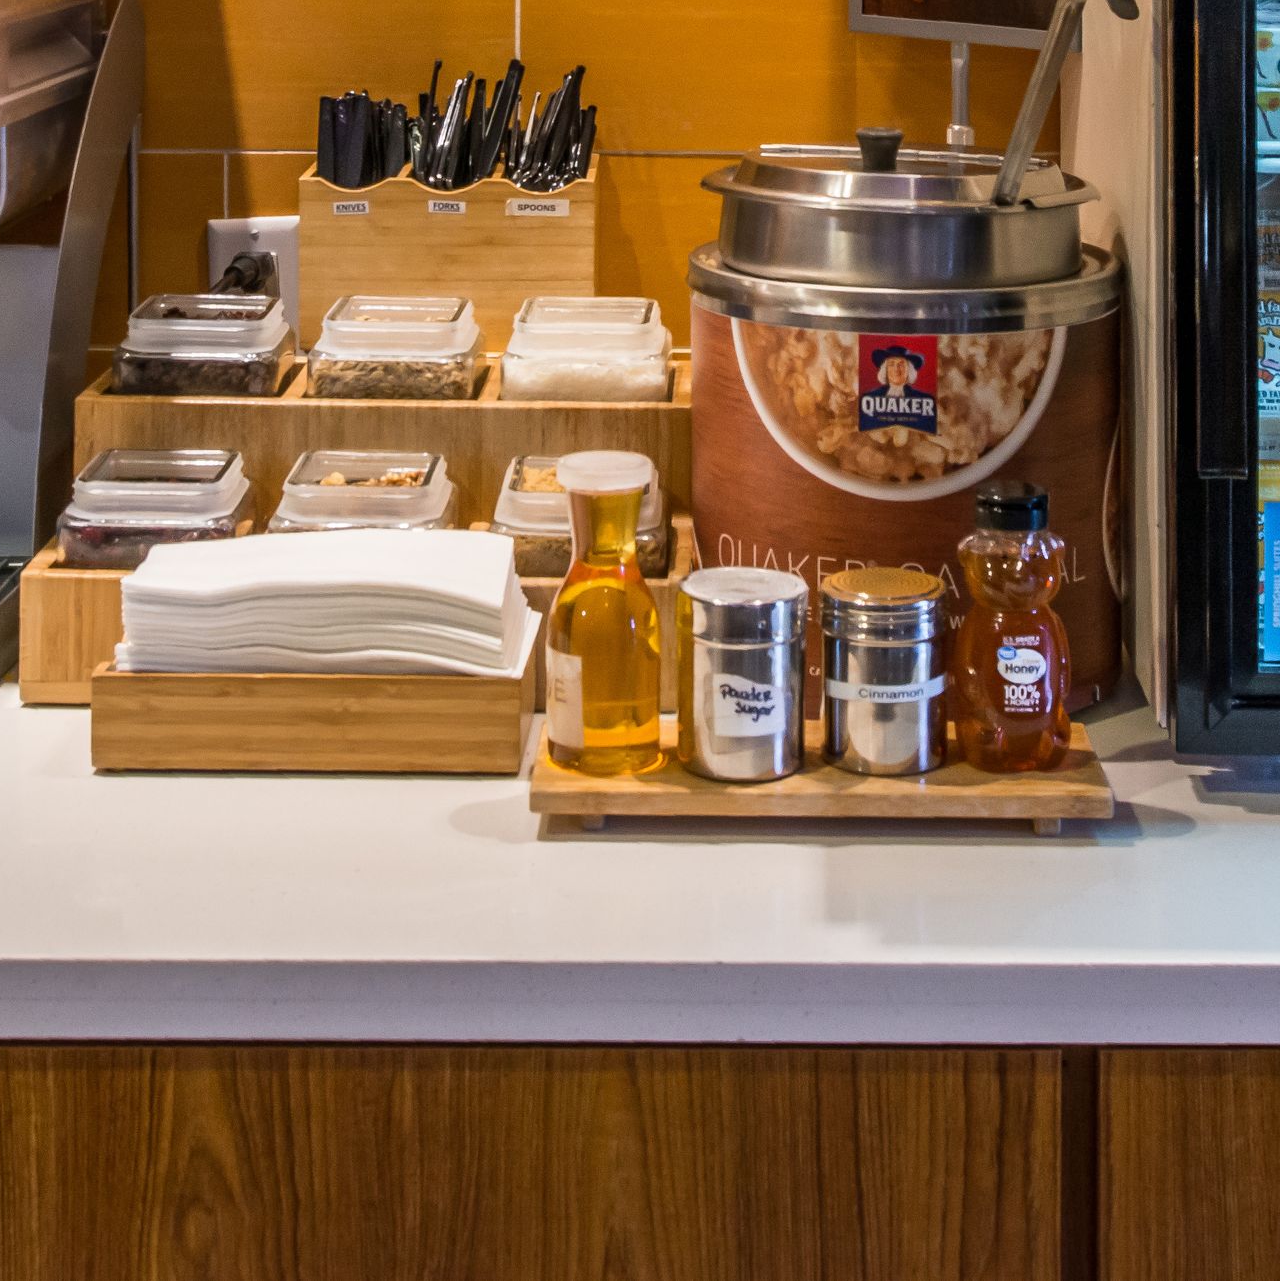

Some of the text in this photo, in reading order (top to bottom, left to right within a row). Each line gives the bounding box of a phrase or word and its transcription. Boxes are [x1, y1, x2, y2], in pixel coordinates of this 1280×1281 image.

[336, 203, 367, 213] KNIVES
[432, 202, 461, 212] FORKS
[517, 204, 557, 212] SPOONS
[861, 396, 935, 417] QUAKER
[1005, 663, 1041, 675] Honey
[858, 686, 925, 700] Cinnamon
[1003, 685, 1041, 699] 100%
